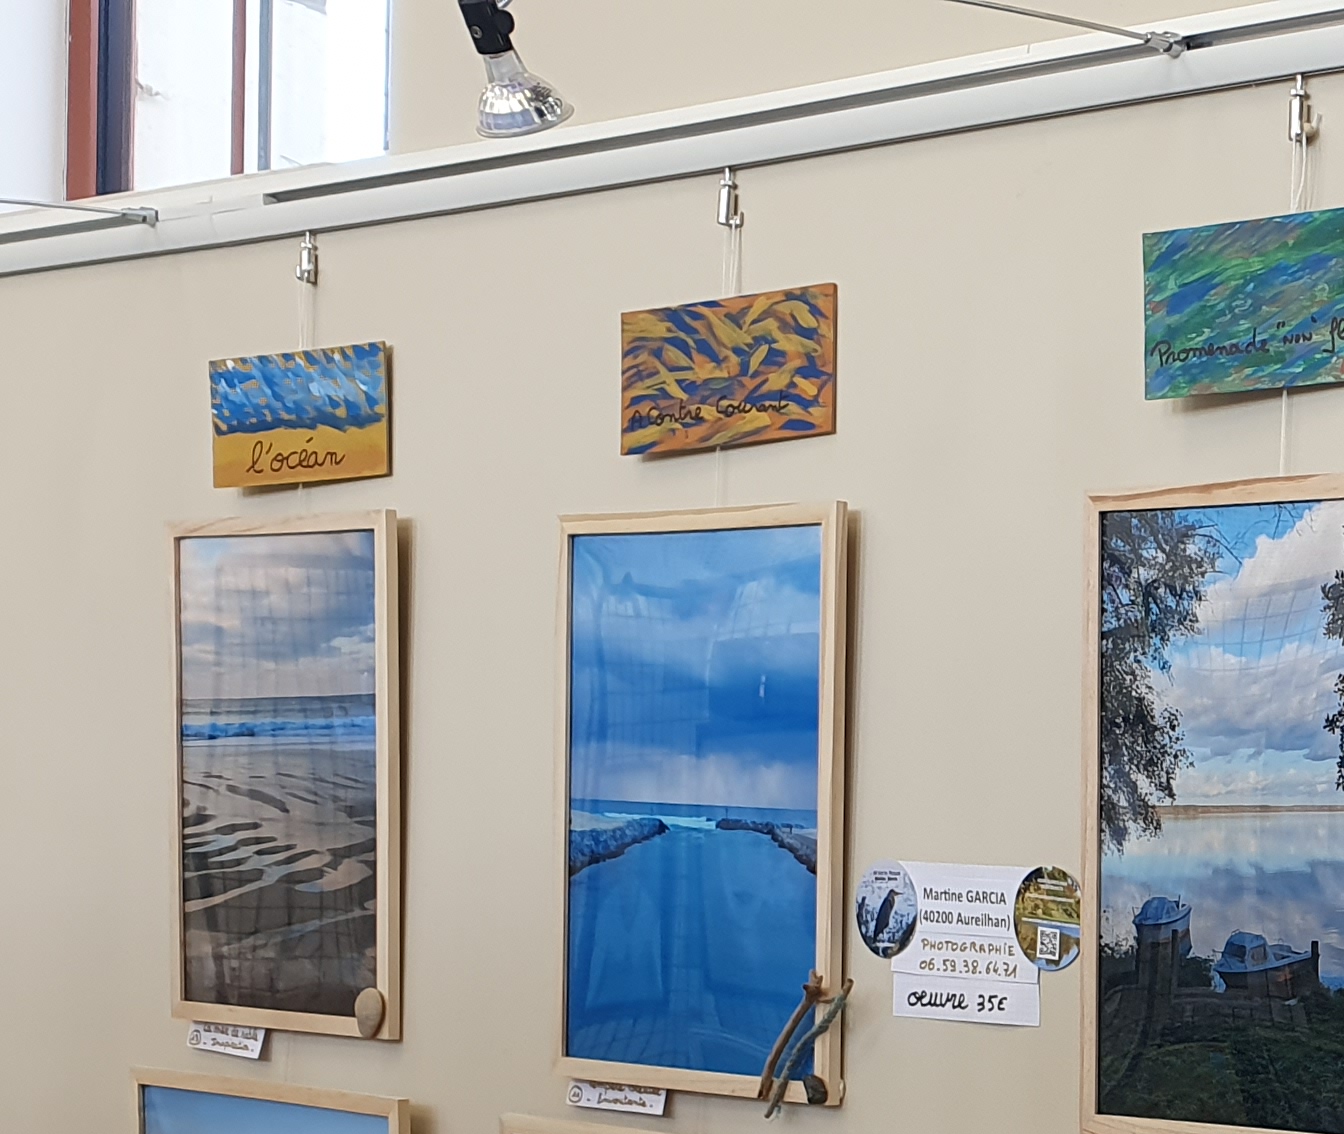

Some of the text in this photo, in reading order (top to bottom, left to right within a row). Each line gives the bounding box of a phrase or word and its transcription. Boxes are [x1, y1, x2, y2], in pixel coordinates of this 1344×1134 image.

[1150, 328, 1269, 367] Promenade
[923, 887, 1007, 906] Martine GARCIA
[919, 909, 954, 926] (40200
[956, 912, 1011, 931] Aureilhan)
